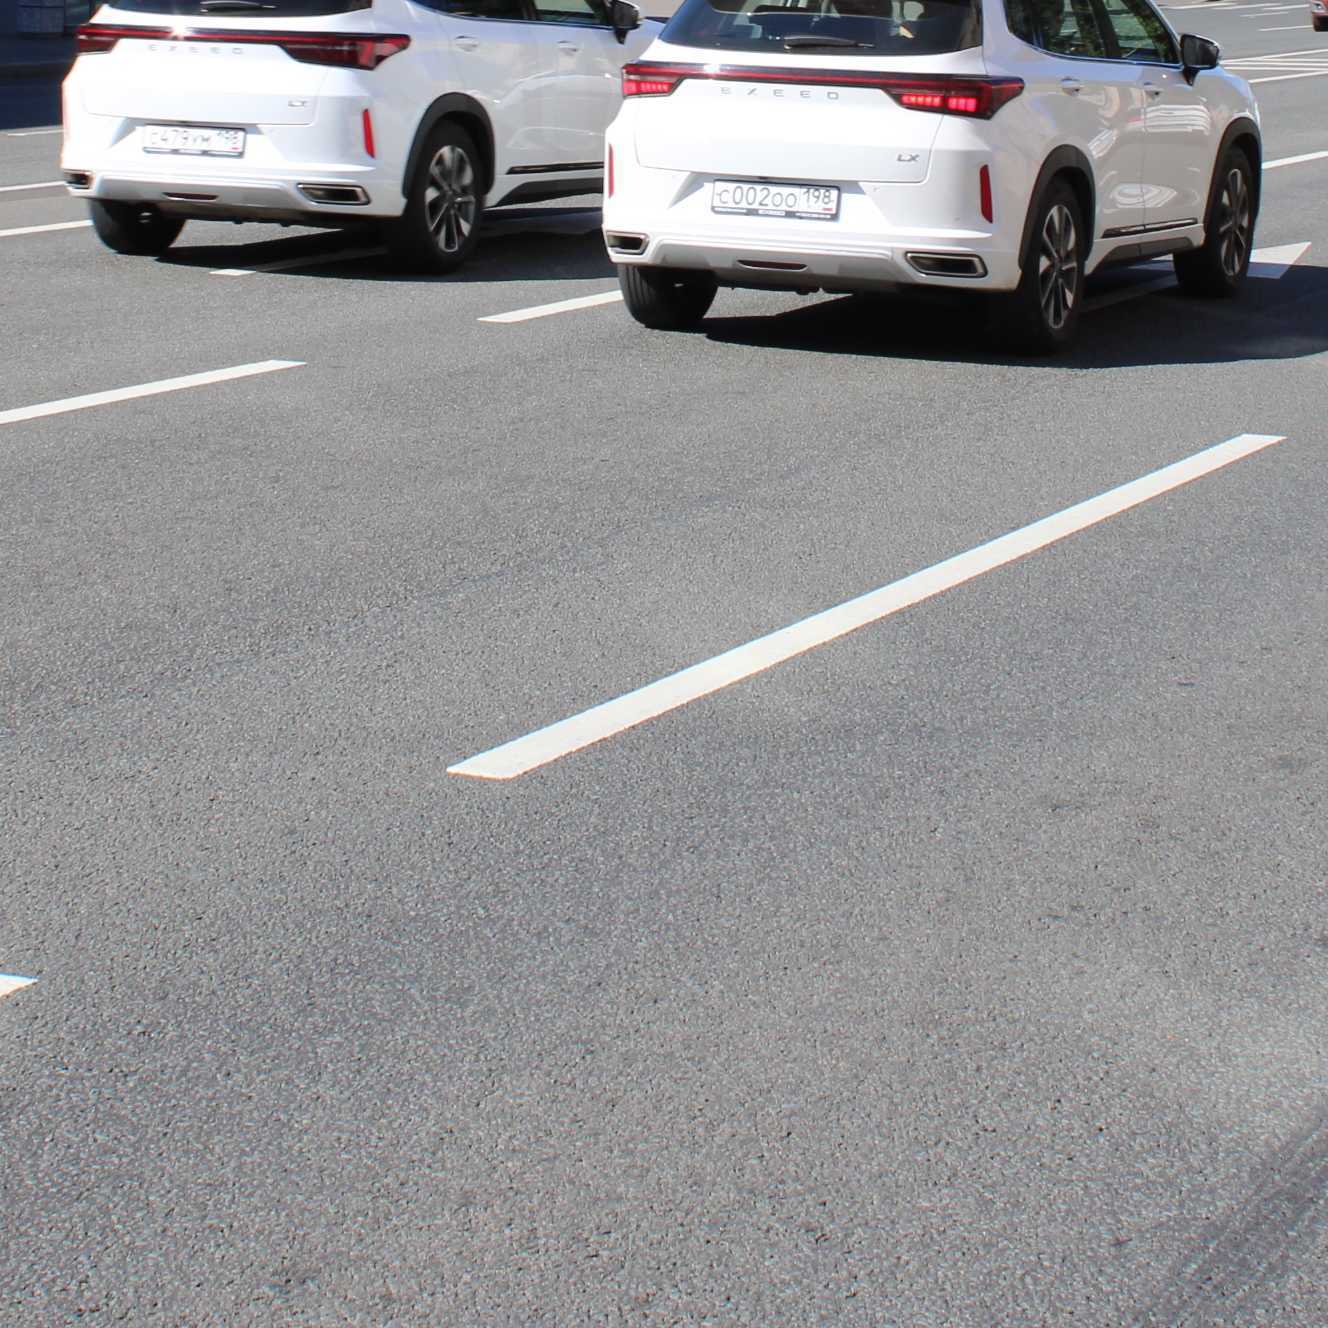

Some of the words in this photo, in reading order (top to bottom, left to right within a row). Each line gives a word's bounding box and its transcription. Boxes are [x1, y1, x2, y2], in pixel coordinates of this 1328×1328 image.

[720, 86, 840, 101] EXEED
[896, 152, 920, 163] LX
[802, 187, 833, 206] 198
